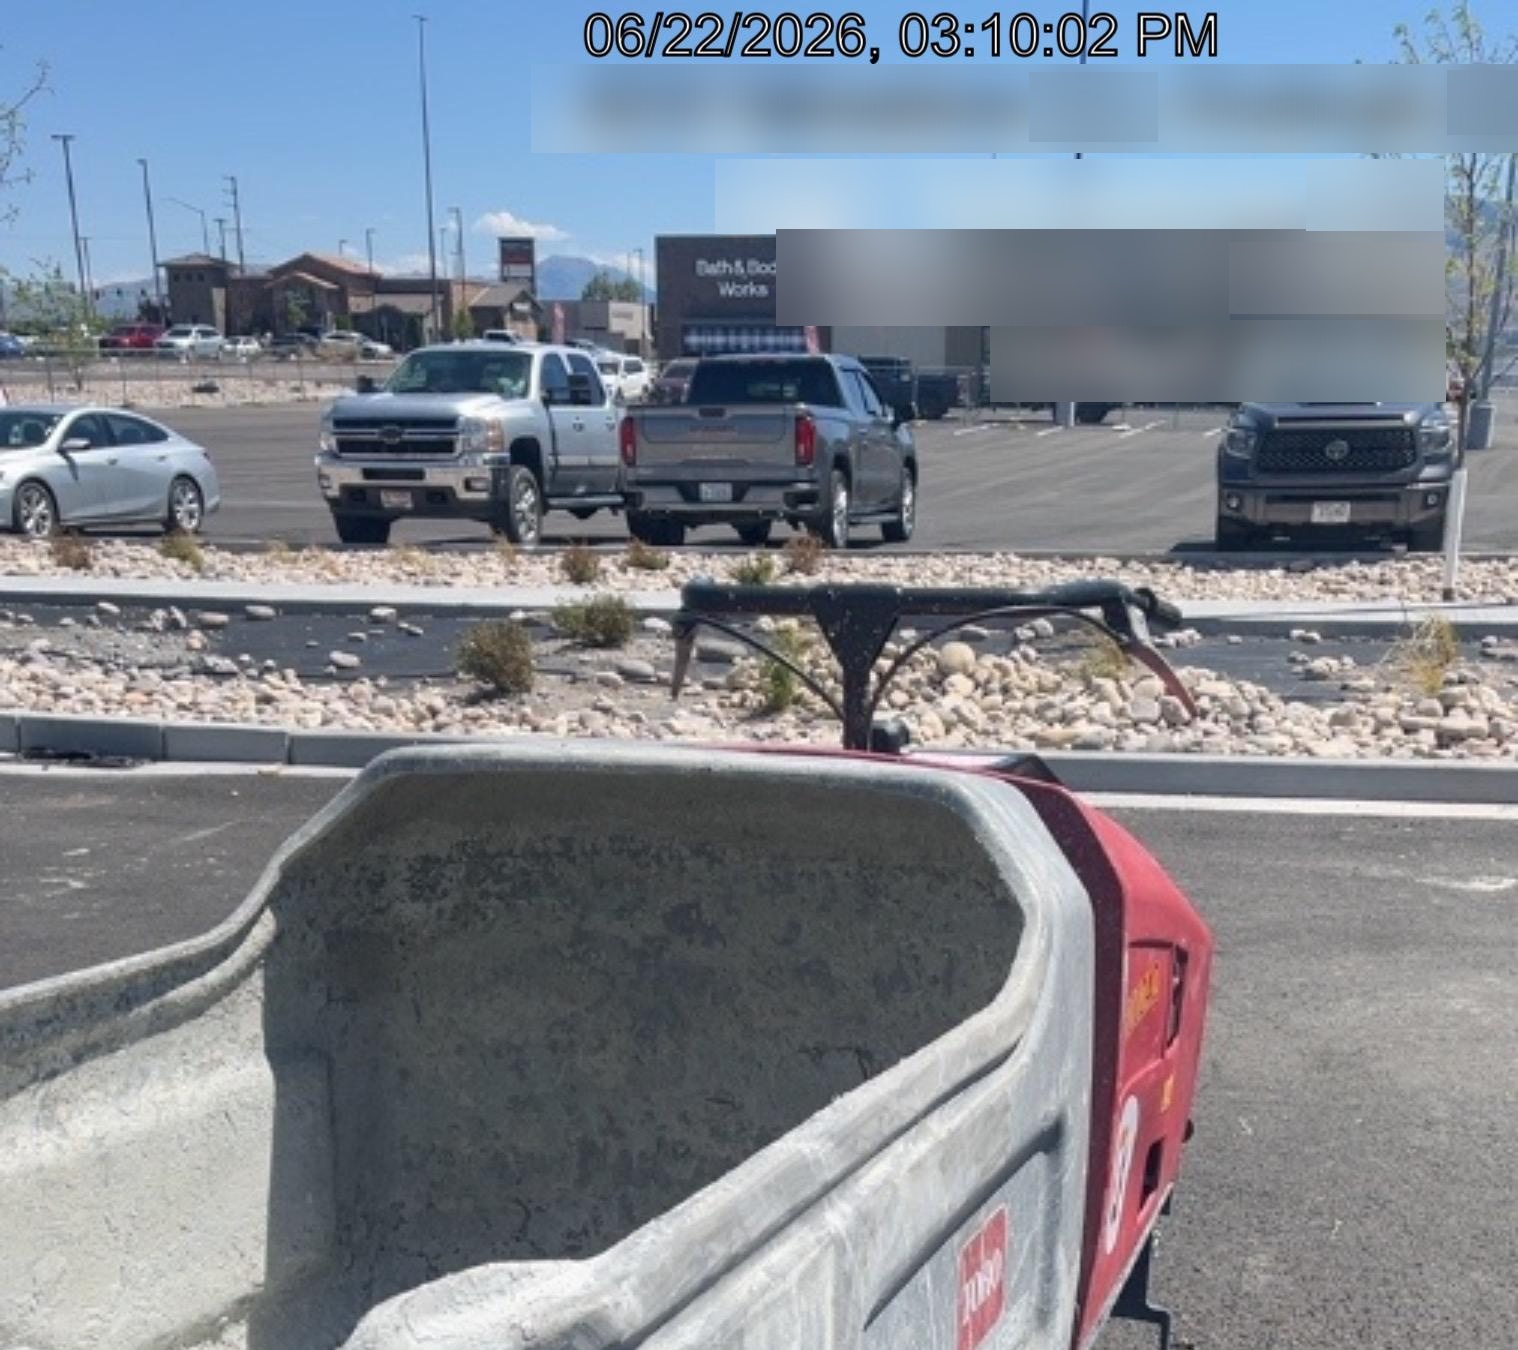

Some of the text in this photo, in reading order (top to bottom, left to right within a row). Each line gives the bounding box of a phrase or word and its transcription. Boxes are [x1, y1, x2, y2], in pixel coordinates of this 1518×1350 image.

[696, 259, 776, 276] Bath & Bod
[718, 281, 769, 297] Works
[962, 1248, 1002, 1325] TORO
